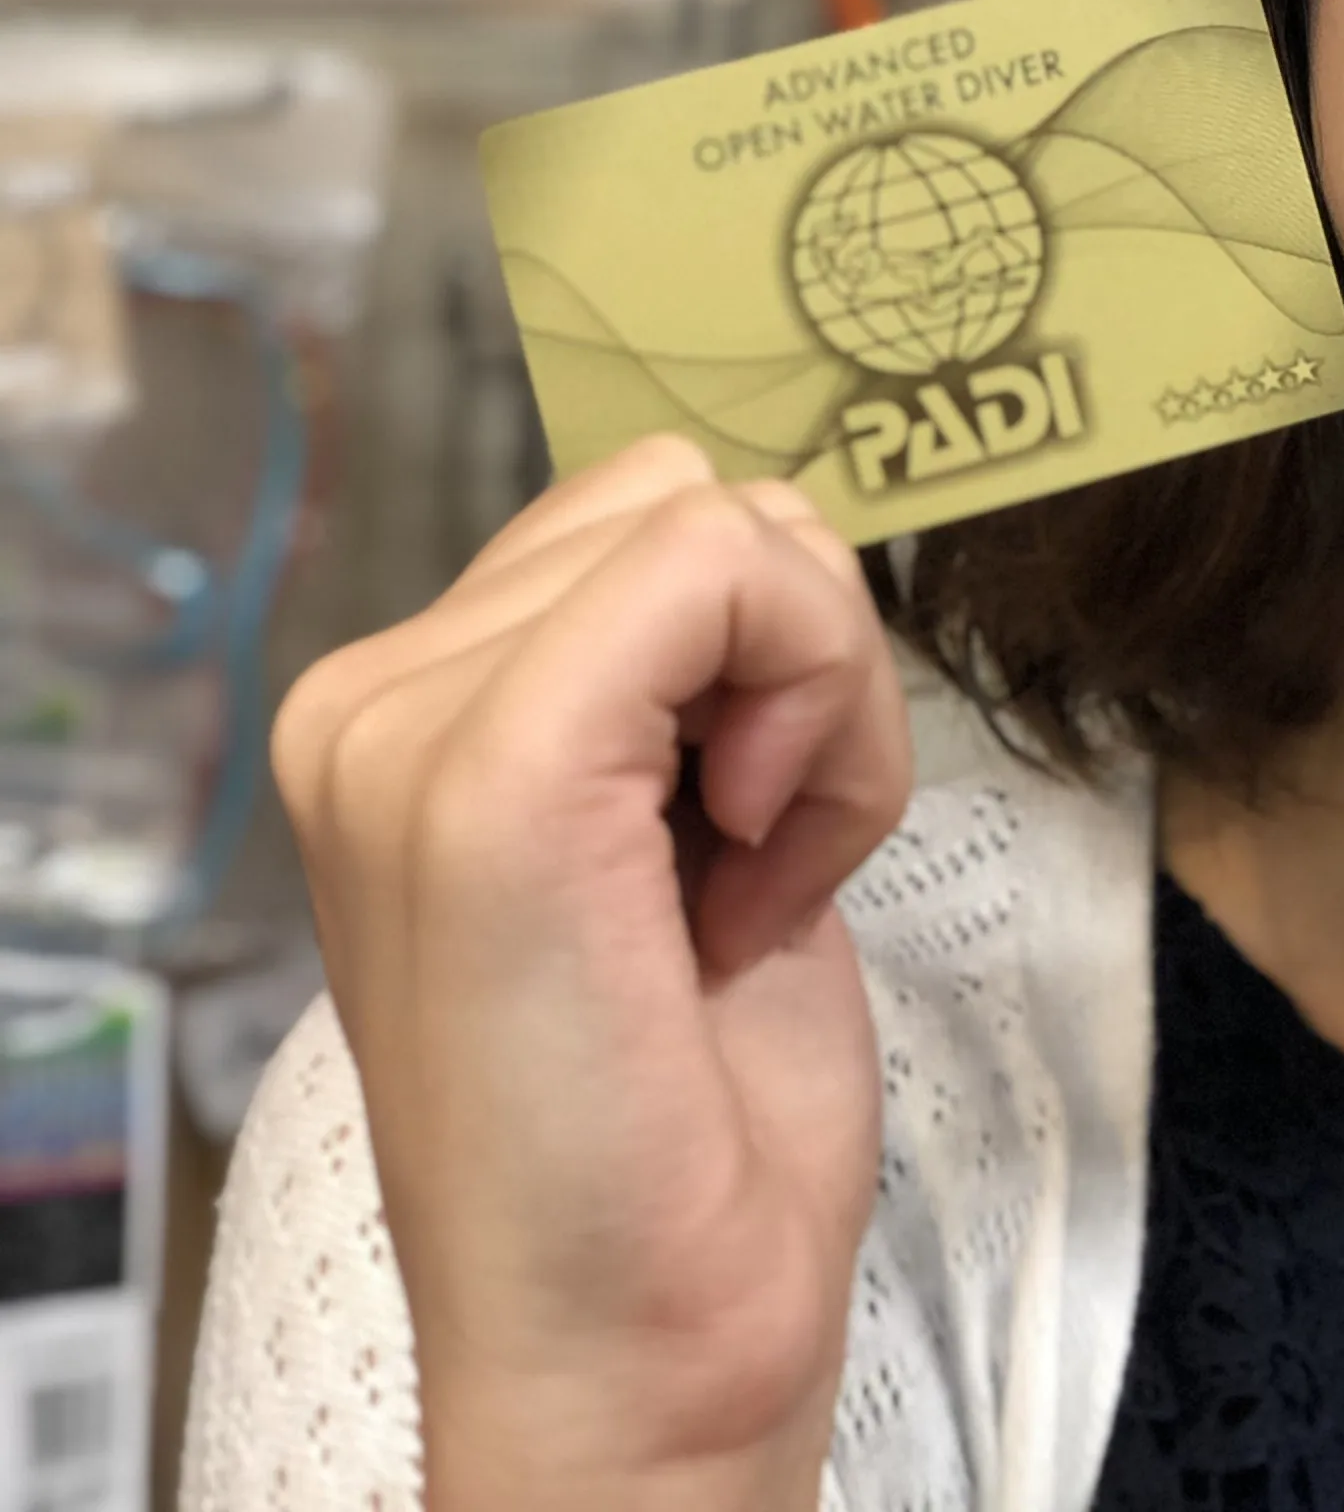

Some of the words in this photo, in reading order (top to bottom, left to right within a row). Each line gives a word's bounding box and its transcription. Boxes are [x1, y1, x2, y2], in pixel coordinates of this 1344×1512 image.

[692, 117, 804, 173] OPEN
[813, 81, 943, 137] WATER
[954, 48, 1065, 103] DIVER
[763, 27, 976, 109] ADVANCED
[842, 351, 1084, 492] PADI
